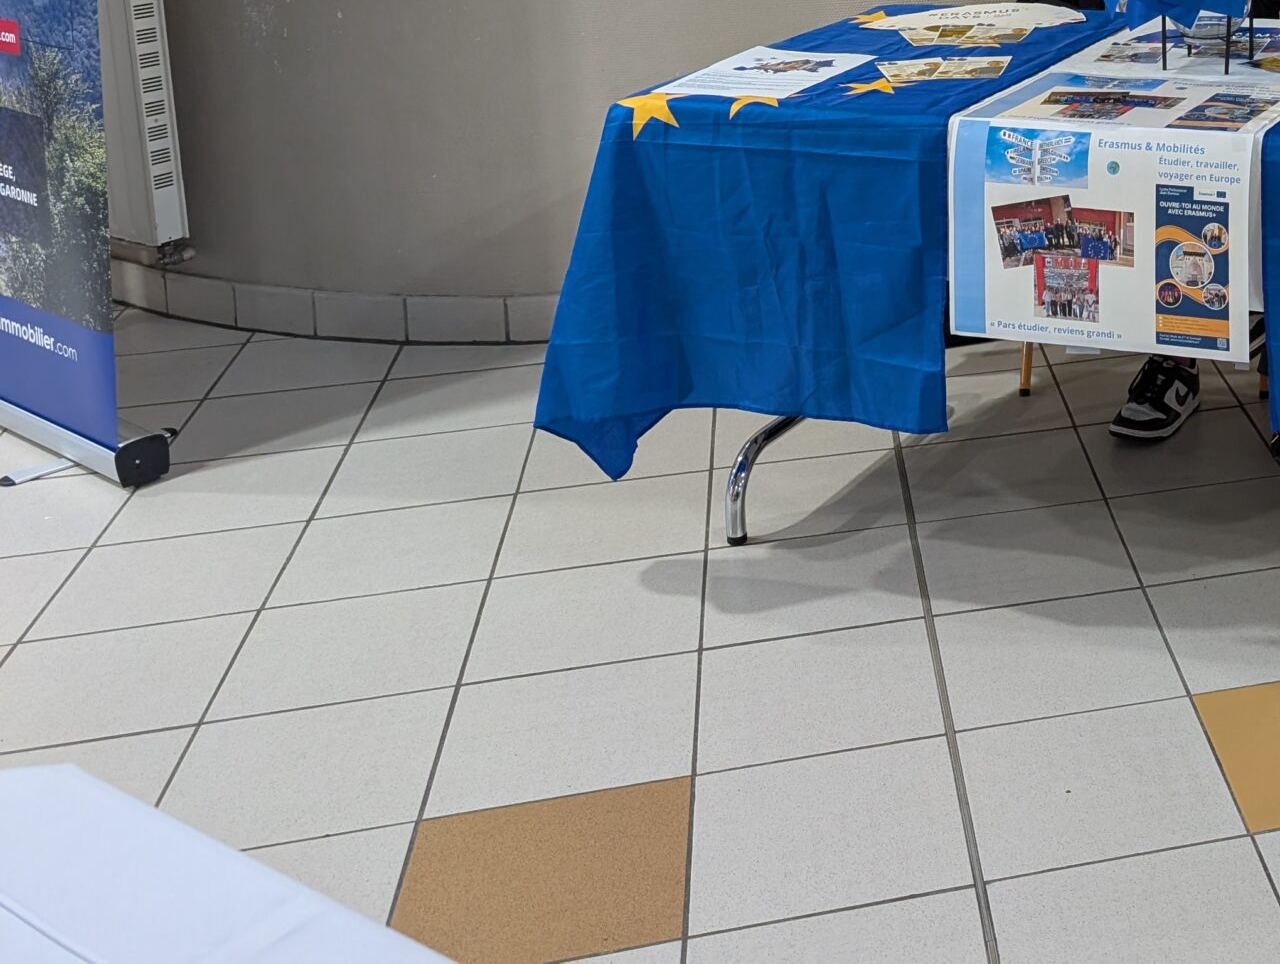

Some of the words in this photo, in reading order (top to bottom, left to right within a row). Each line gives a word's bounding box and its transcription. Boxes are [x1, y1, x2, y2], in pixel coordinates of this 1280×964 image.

[1011, 135, 1034, 147] FRANCE
[1098, 138, 1143, 151] Erasmus
[1145, 142, 1153, 151] &
[1156, 142, 1206, 155] Mobilités
[1158, 156, 1194, 168] Étudier,
[1195, 159, 1240, 172] travailler,
[1157, 171, 1194, 182] voyager
[1195, 174, 1207, 182] en
[1209, 174, 1241, 186] Europe
[0, 182, 38, 206] GARONNE
[1159, 200, 1191, 210] OUVRE-TOI
[1192, 202, 1201, 210] AU
[1201, 203, 1225, 212] MONDE
[1167, 208, 1183, 216] AVEC
[1184, 209, 1217, 218] ERASMUS+
[997, 320, 1017, 330] Pars
[1018, 322, 1051, 335] étudier,
[1053, 325, 1085, 336] reviens
[1086, 328, 1116, 340] grandi
